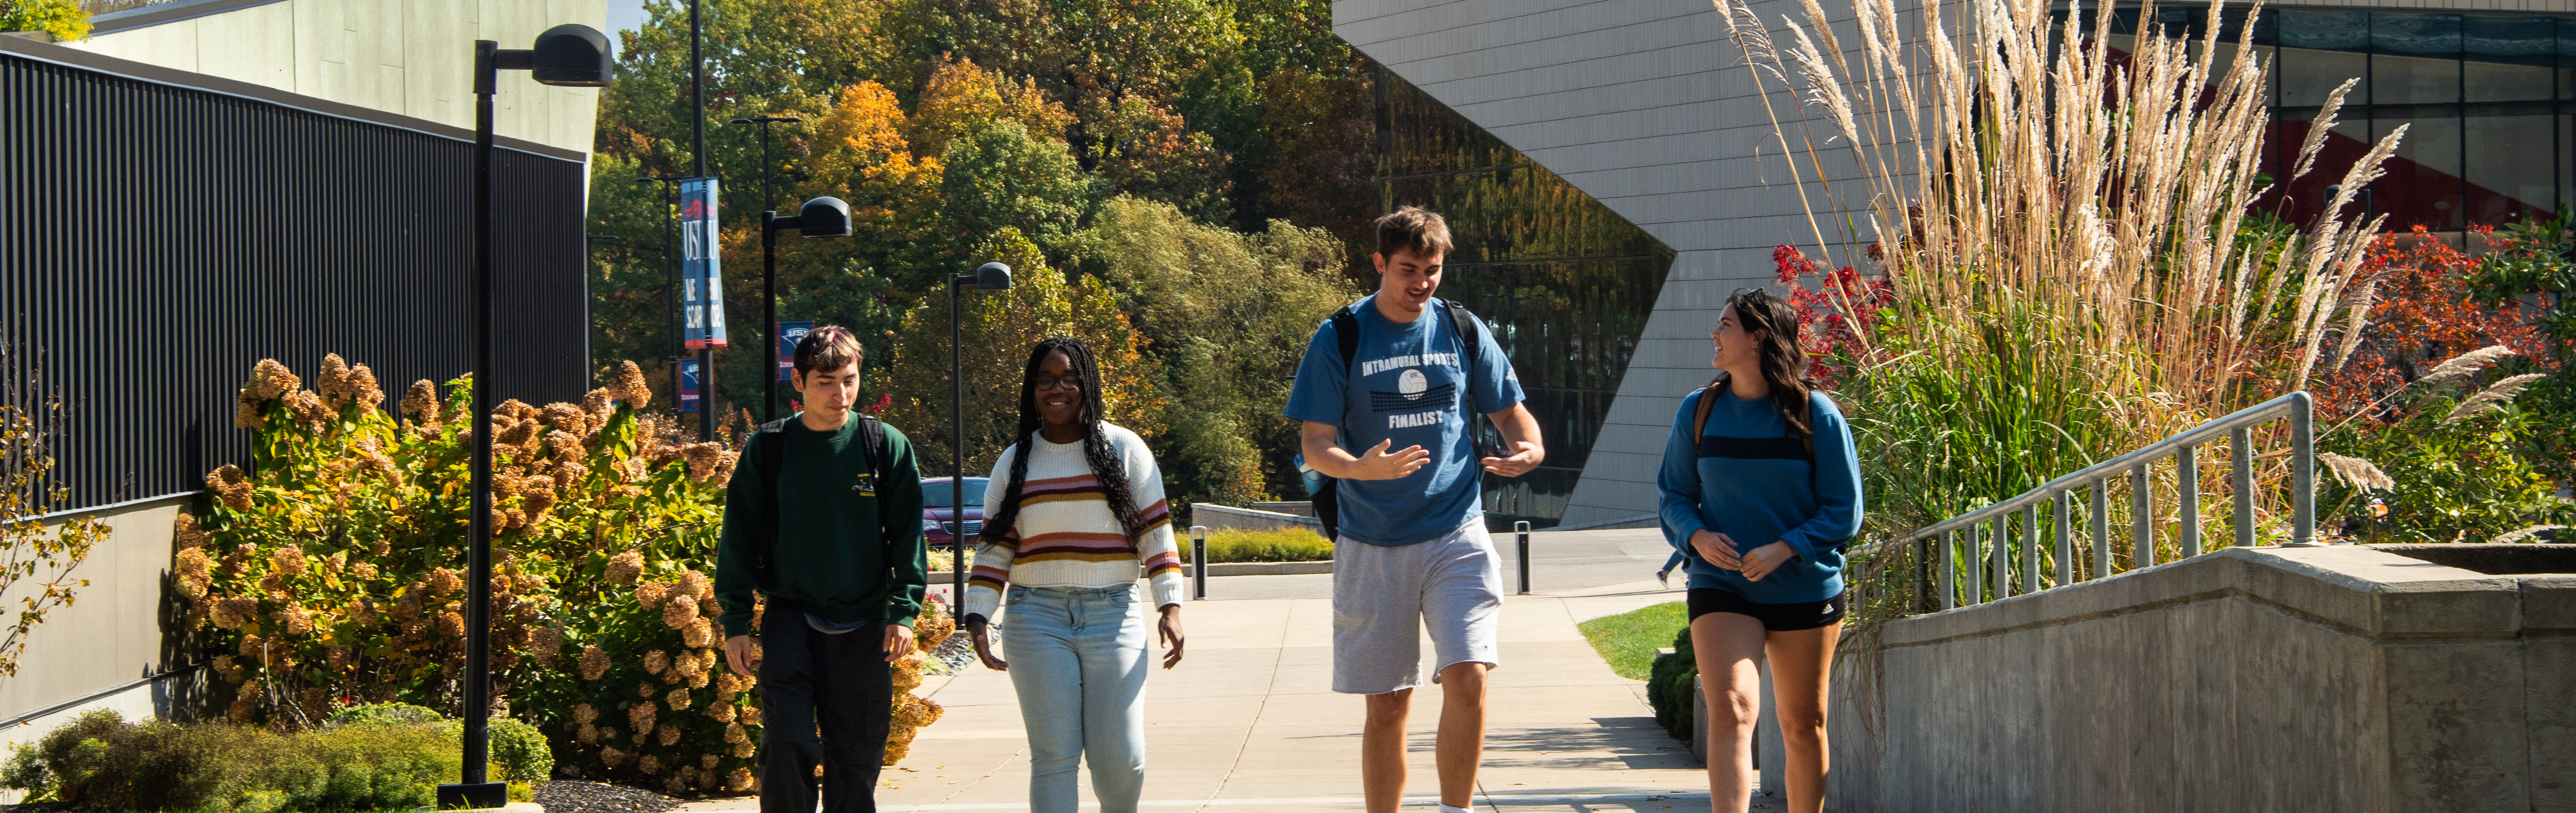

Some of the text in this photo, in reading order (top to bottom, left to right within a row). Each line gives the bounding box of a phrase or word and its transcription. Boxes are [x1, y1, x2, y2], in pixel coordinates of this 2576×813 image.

[1362, 353, 1459, 376] INTRAMURAL SPORTS
[1389, 410, 1443, 429] FINALIST
